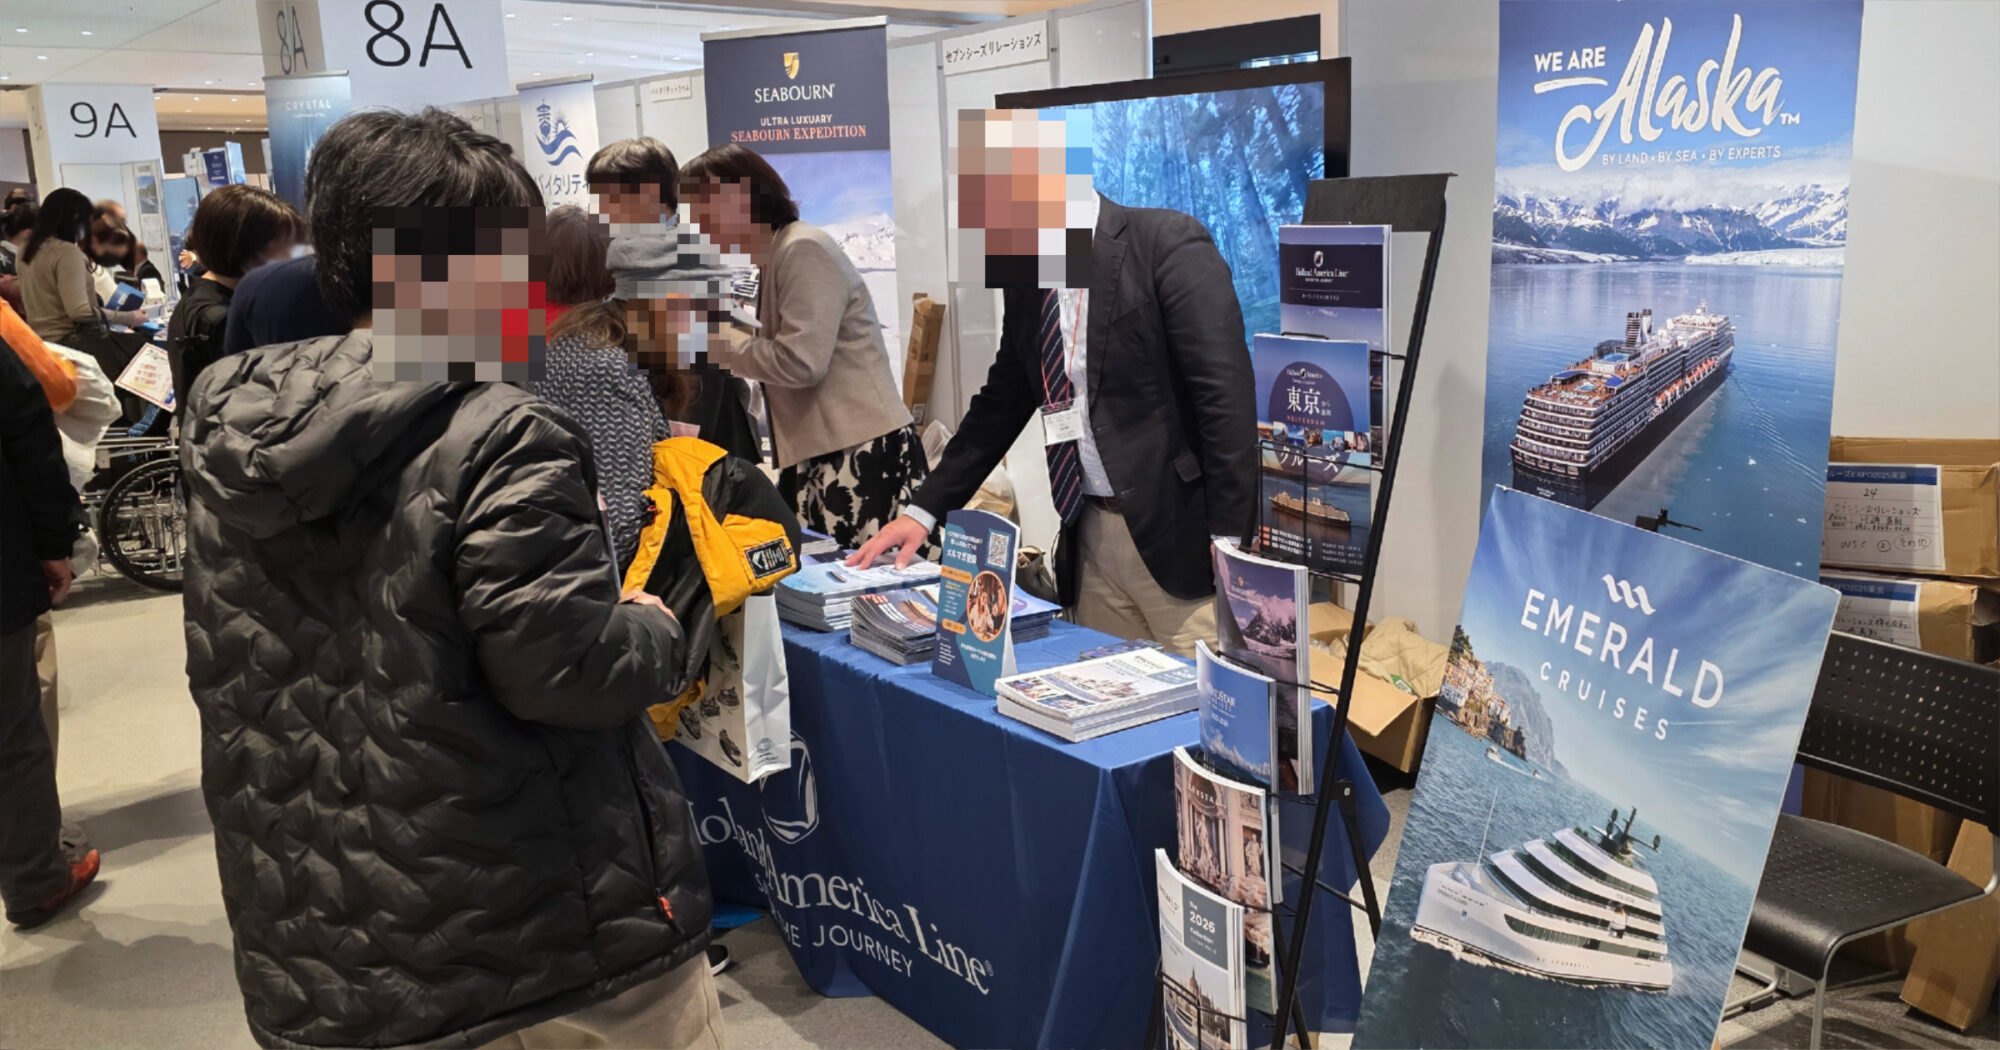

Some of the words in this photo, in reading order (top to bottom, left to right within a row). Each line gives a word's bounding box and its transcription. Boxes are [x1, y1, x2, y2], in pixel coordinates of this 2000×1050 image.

[277, 6, 308, 75] 8A
[364, 0, 472, 69] 8A
[945, 31, 1042, 64] セブンシーズリレーションズ
[1534, 51, 1563, 72] WE
[1567, 46, 1606, 70] ARE
[286, 99, 332, 111] CRYSTAL
[754, 84, 835, 103] SEABOURN
[1554, 14, 1785, 172] Alaska
[70, 102, 137, 138] 9A
[731, 129, 790, 143] SEABOURN
[793, 125, 867, 140] EXPEDITION
[760, 117, 789, 126] ULTRA
[791, 114, 833, 125] LUXUARY
[1602, 153, 1616, 165] BY
[1618, 152, 1648, 164] LAND
[1658, 151, 1673, 163] BY
[1675, 149, 1698, 162] SEA
[1709, 148, 1724, 161] BY
[1728, 146, 1782, 160] EXPERTS
[1286, 386, 1321, 415] 東京
[1279, 445, 1340, 473] クルーズ
[1521, 588, 1724, 708] EMERALD
[1540, 662, 1669, 740] CRUISES
[763, 843, 911, 943] America
[903, 903, 989, 995] Line
[1189, 911, 1216, 934] 2026
[813, 924, 913, 978] JOURNEY
